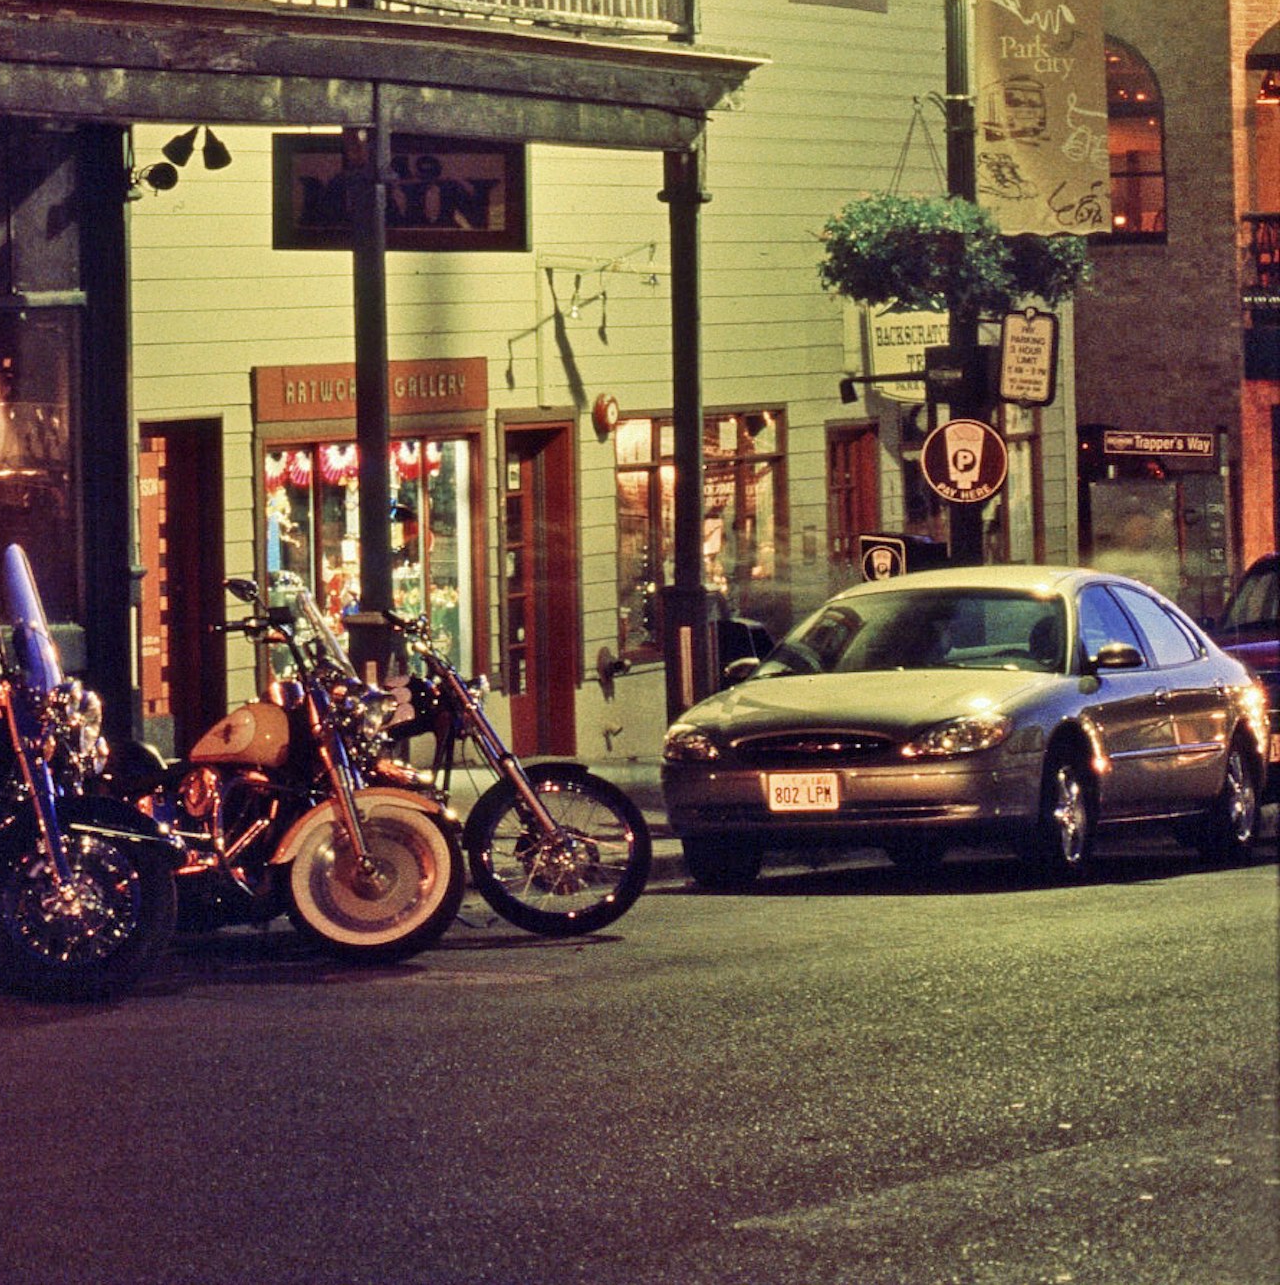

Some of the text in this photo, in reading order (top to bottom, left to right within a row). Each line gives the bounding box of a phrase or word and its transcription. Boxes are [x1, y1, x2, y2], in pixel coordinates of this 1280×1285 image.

[999, 34, 1050, 58] Park
[1034, 57, 1076, 81] city
[286, 373, 466, 404] ARTWOR GALLERY
[1134, 435, 1184, 451] Trapper's
[1187, 437, 1211, 453] Way
[937, 482, 992, 500] PAY HERE
[775, 786, 799, 804] 802
